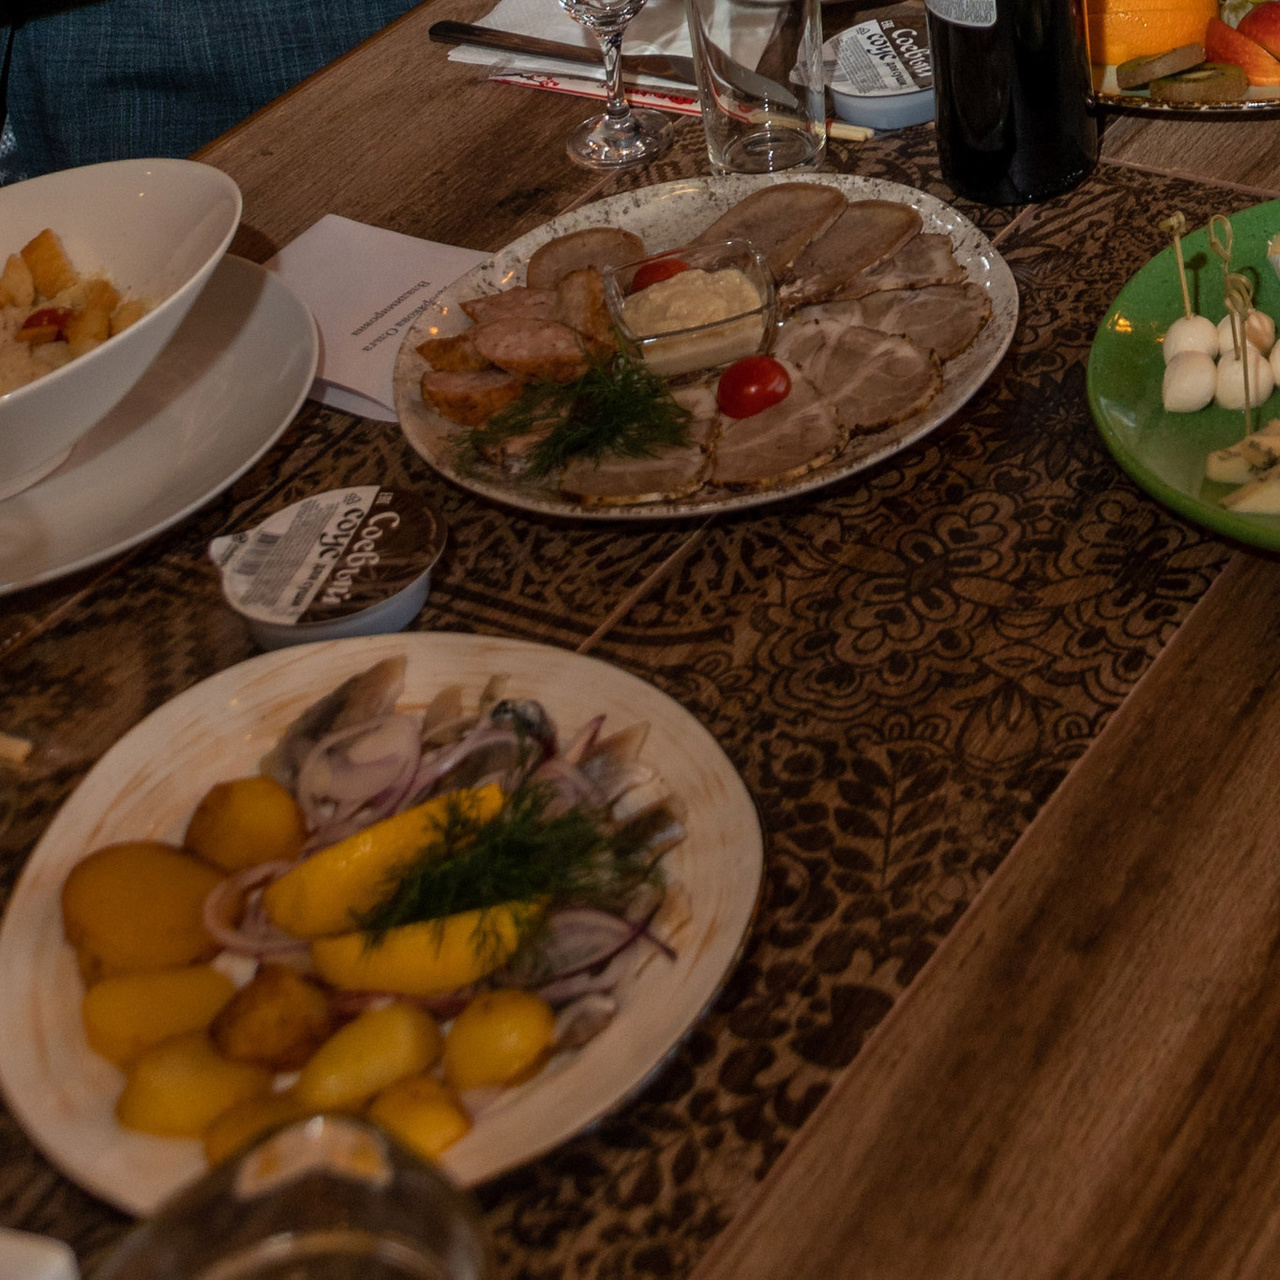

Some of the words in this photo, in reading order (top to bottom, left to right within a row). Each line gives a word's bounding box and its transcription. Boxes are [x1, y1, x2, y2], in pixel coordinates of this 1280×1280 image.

[866, 33, 898, 61] соус
[351, 280, 431, 337] Владимировна
[362, 327, 399, 352] Ольга
[319, 507, 365, 560] соус
[322, 511, 400, 604] Соевый
